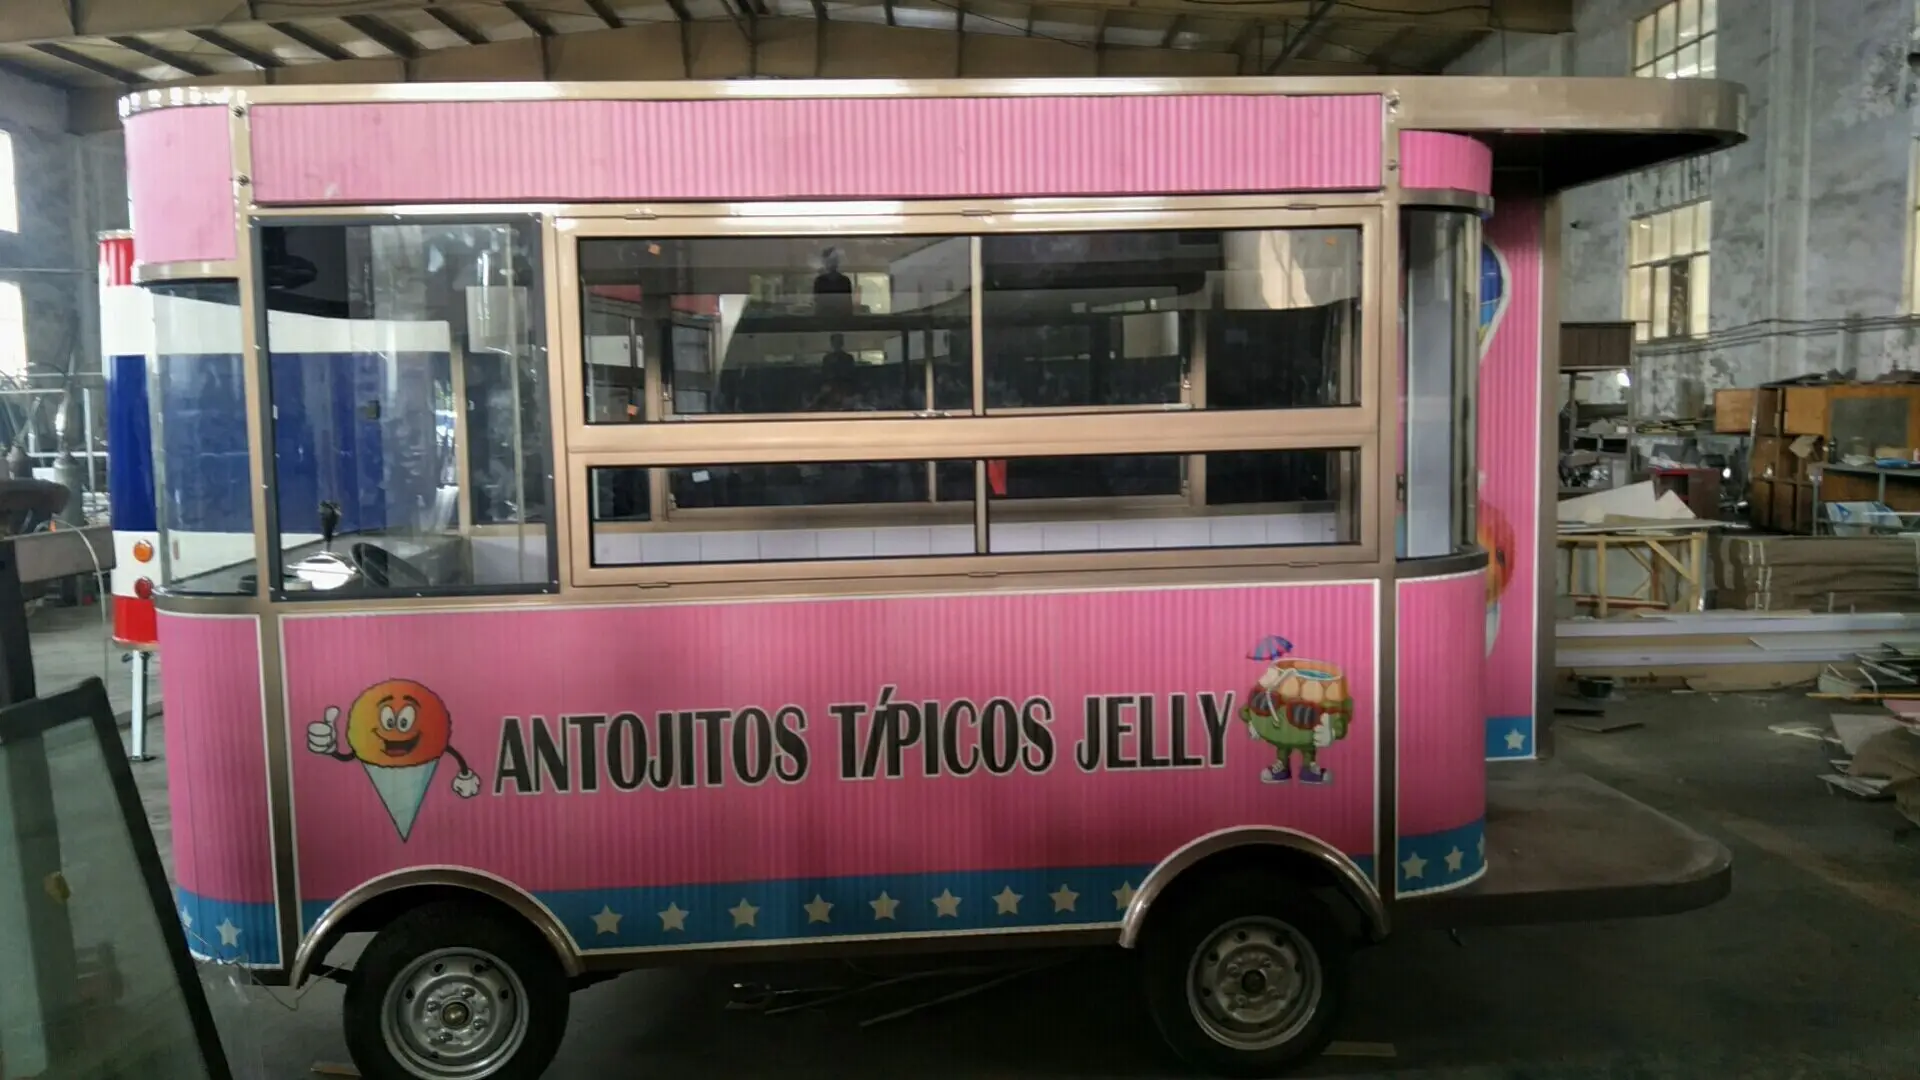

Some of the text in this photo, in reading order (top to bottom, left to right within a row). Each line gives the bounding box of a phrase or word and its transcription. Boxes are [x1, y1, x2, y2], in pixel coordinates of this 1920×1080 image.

[493, 685, 1235, 796] ANTOJITOS TÍPICOS JELLY
